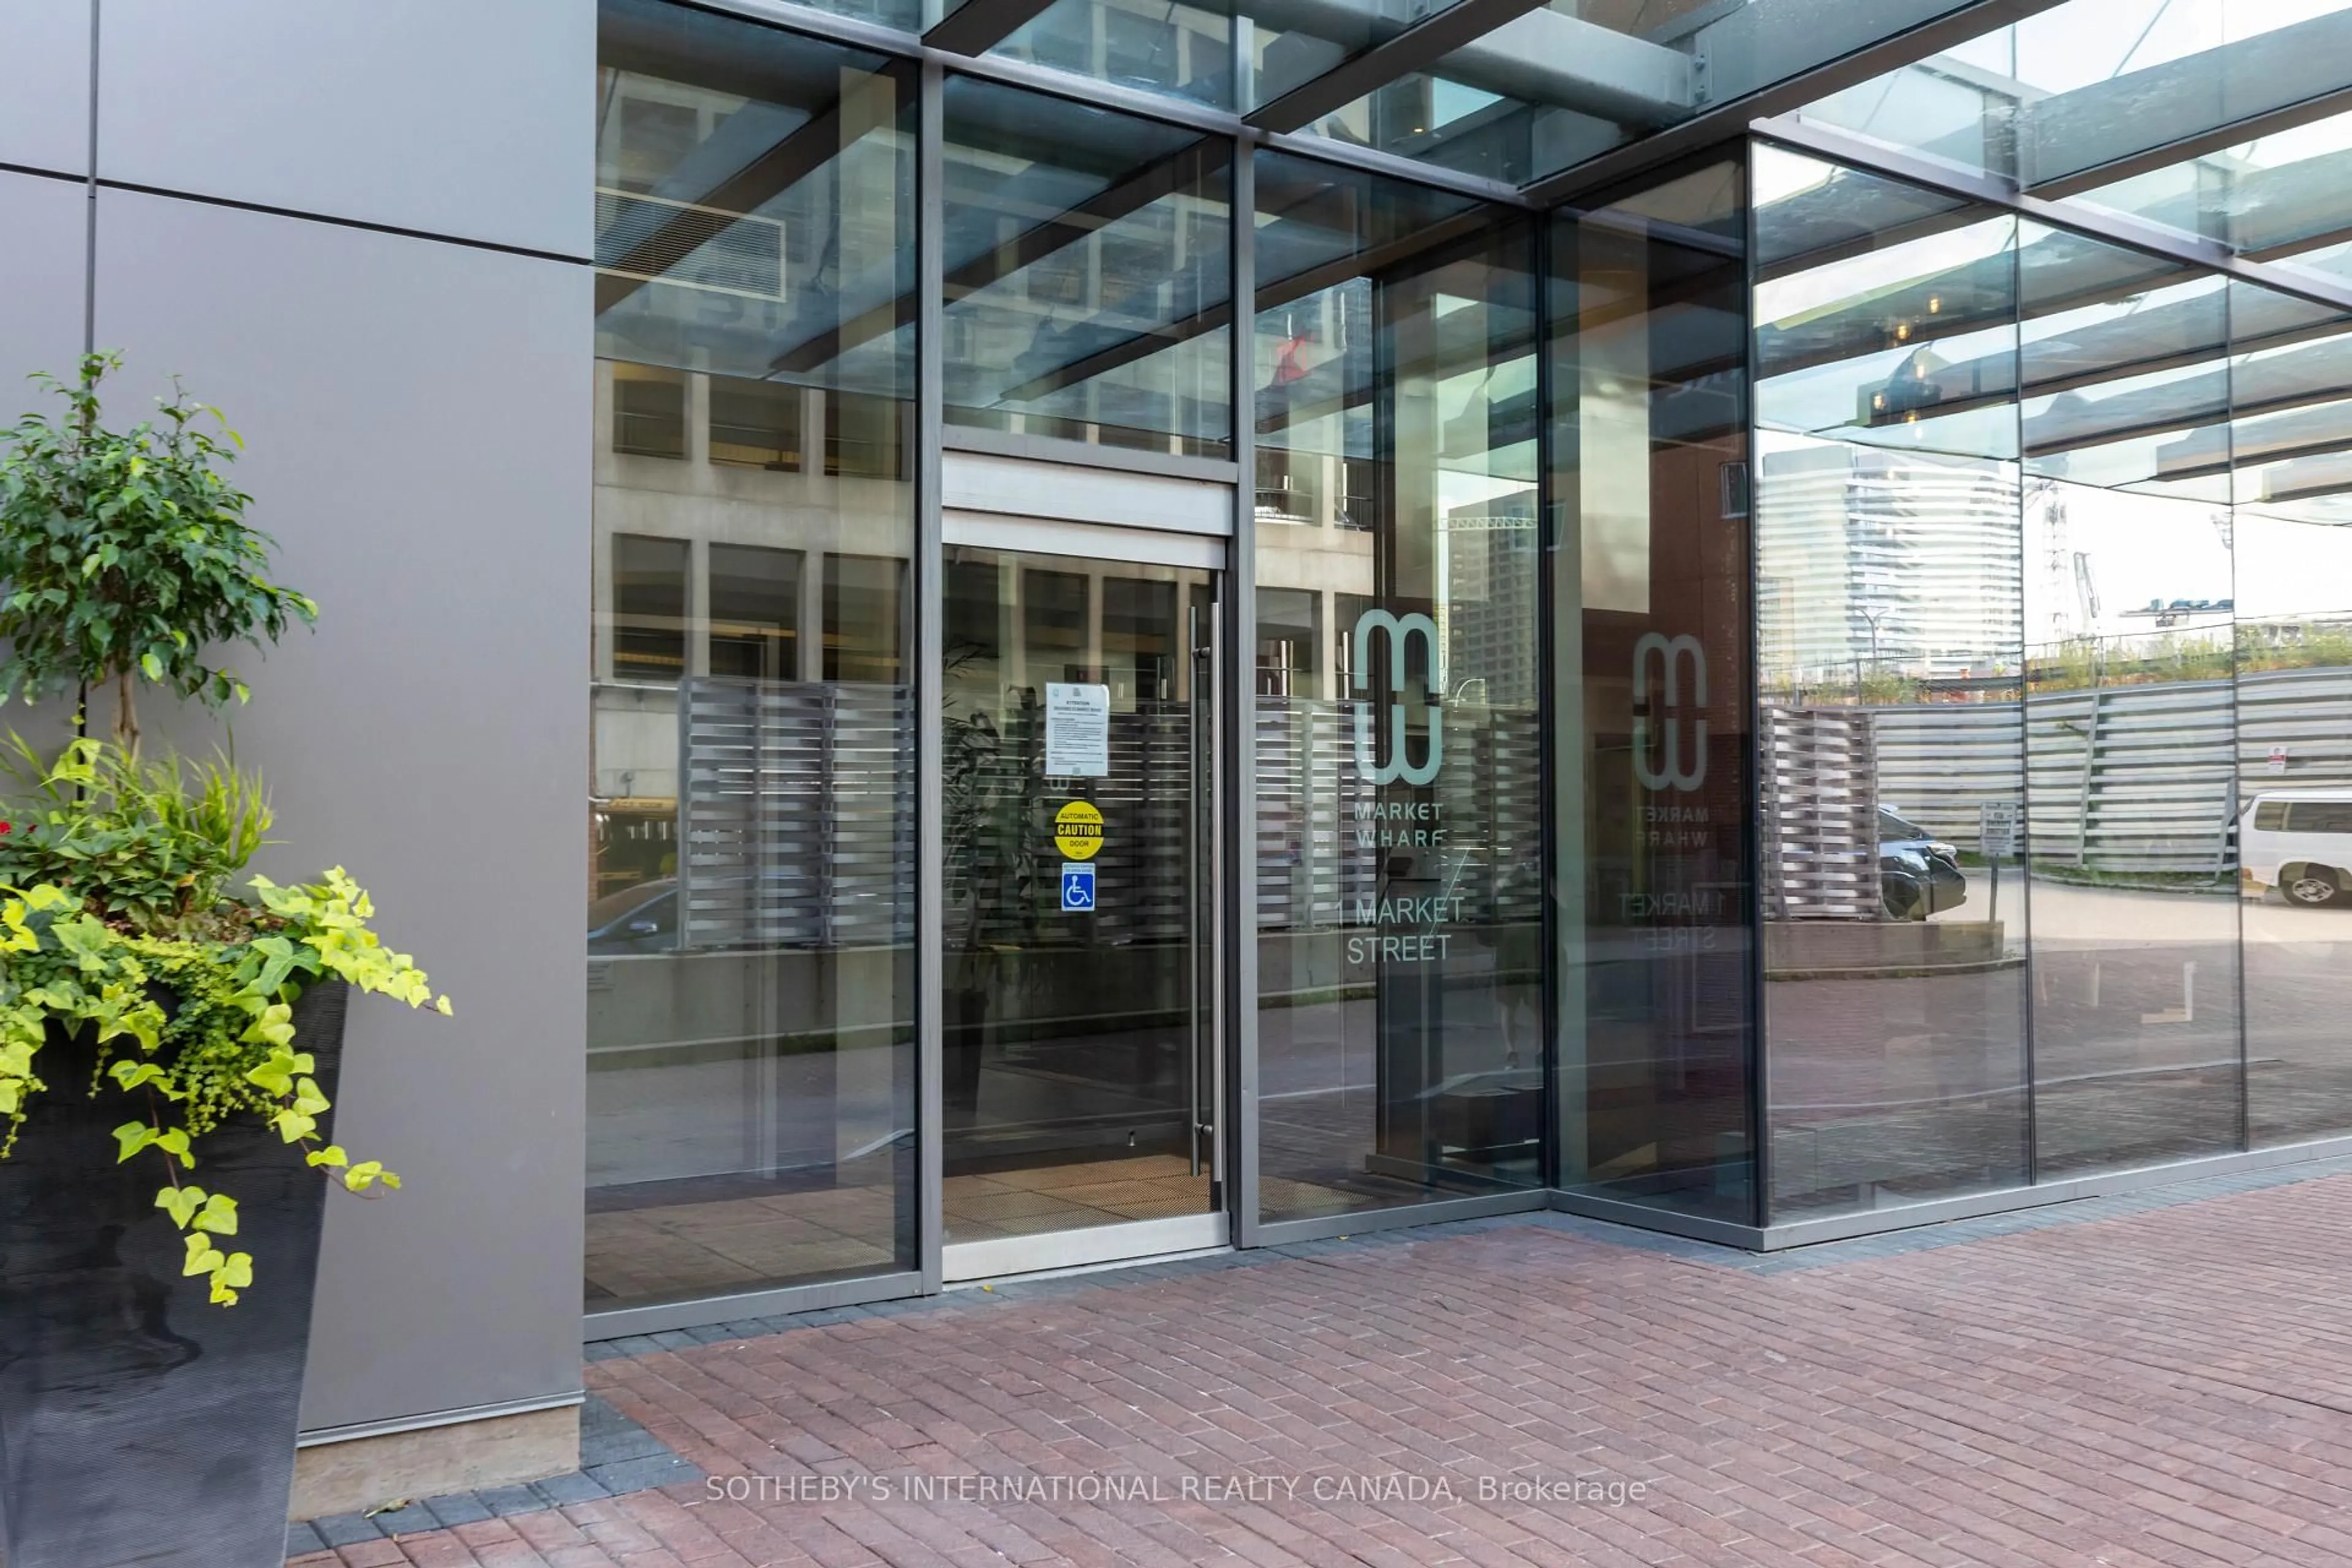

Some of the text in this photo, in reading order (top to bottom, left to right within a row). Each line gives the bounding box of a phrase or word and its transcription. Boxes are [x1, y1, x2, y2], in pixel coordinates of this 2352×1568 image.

[1354, 802, 1444, 820] MARKET
[1058, 824, 1102, 836] CAUTION
[1356, 829, 1446, 848] WHARF
[1355, 897, 1465, 924] MARKET
[1348, 934, 1452, 964] STREET
